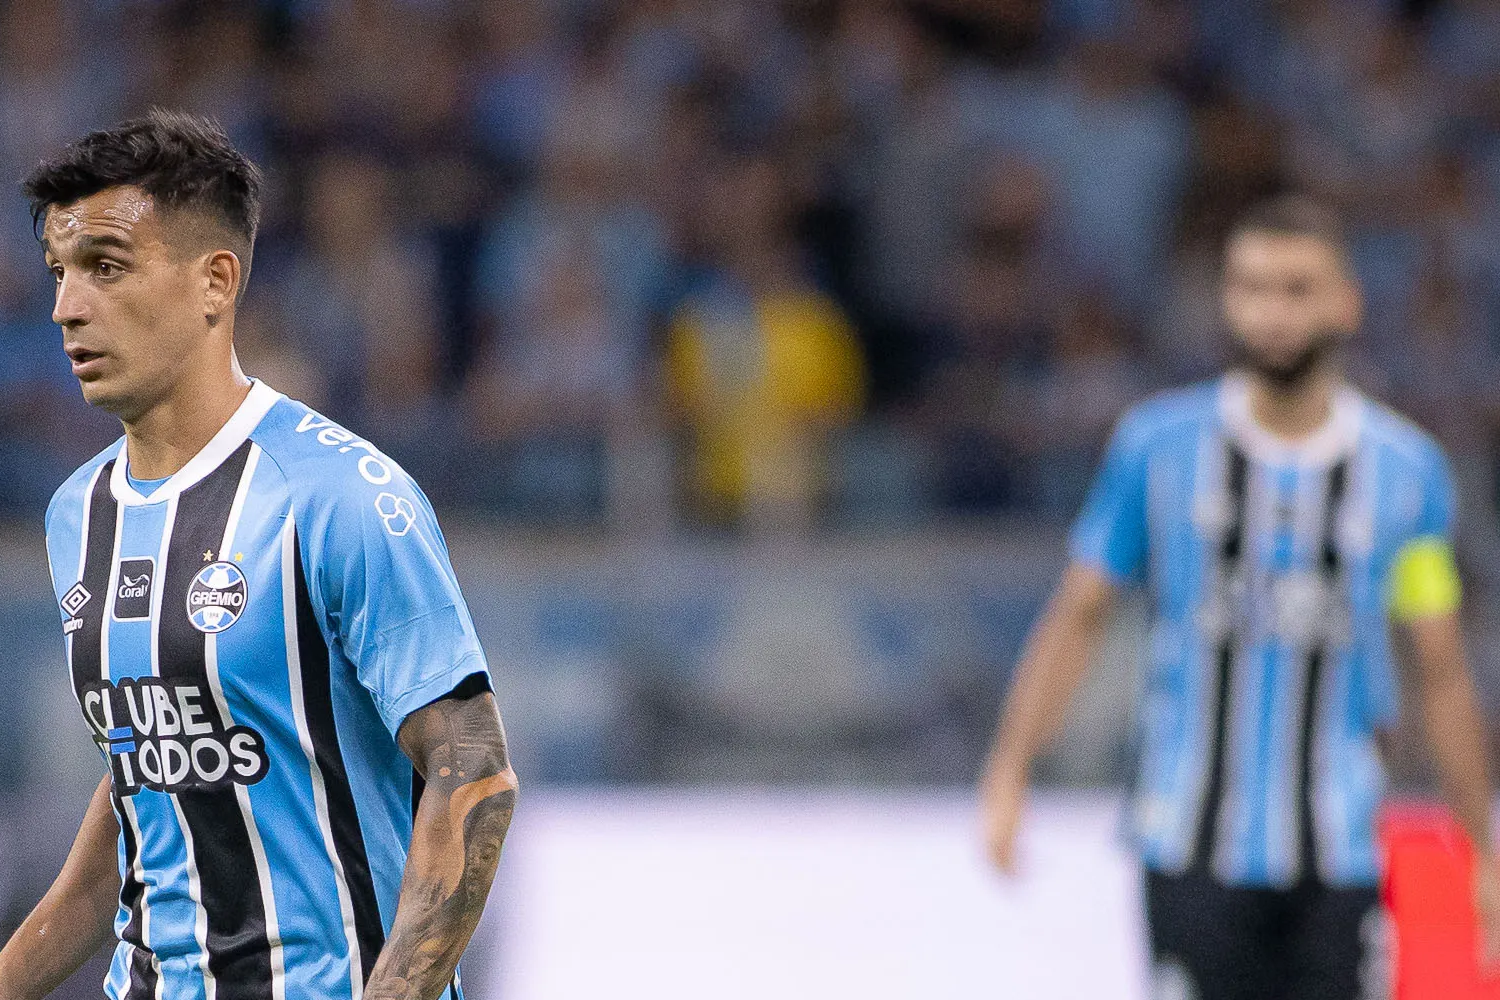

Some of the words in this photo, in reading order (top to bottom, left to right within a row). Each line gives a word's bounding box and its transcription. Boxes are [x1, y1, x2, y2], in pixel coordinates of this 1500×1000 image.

[295, 412, 392, 485] vero
[118, 584, 145, 599] Coral
[190, 588, 243, 607] GRÊMIO
[64, 617, 84, 635] bro
[84, 685, 213, 740] CLUBE
[110, 732, 261, 787] TODOS
